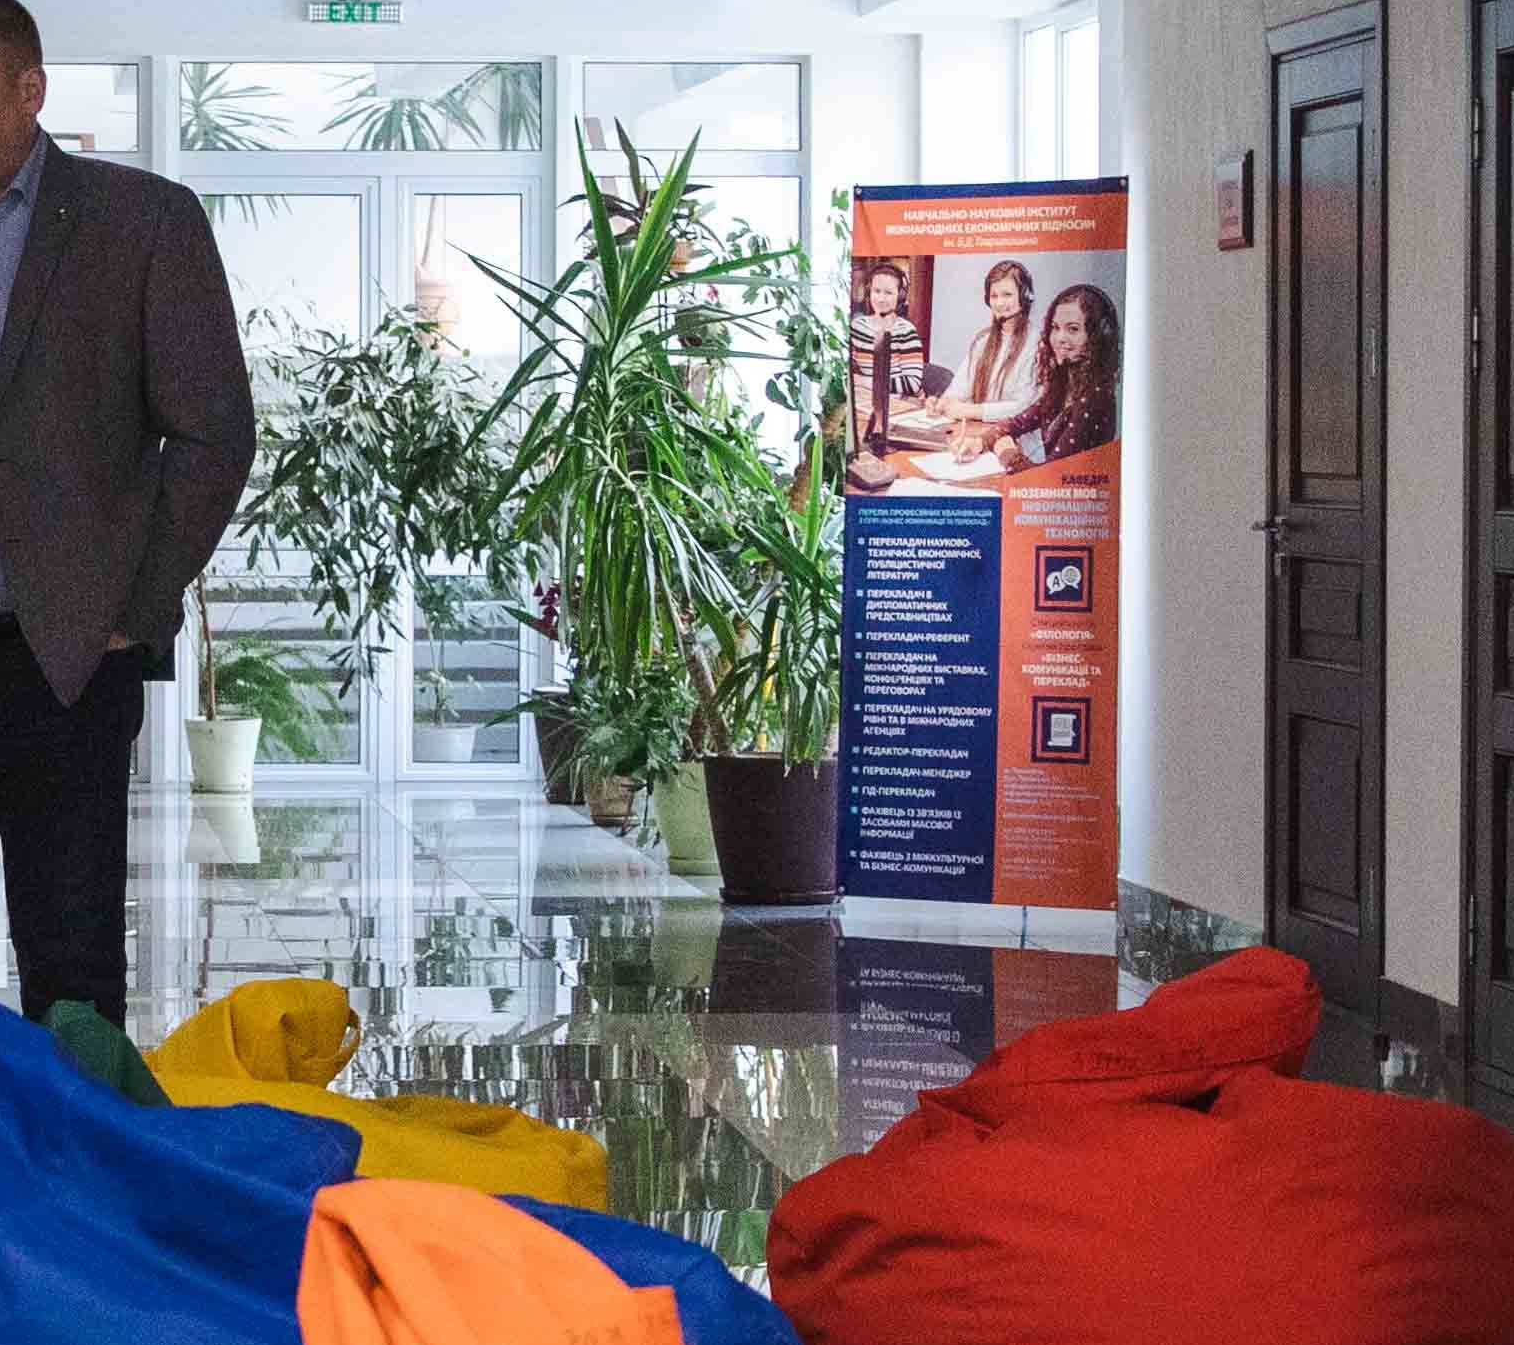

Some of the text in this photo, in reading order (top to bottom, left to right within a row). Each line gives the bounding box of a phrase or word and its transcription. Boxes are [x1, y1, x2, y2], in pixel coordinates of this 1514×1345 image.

[329, 1, 382, 22] EXIT
[868, 537, 926, 547] ПЕРЕКЛАДАЧ
[866, 589, 925, 600] ПЕРЕКЛАДАЧ
[865, 652, 938, 663] ПЕРЕКЛАДАЧ НА
[934, 676, 945, 685] ТА
[863, 685, 926, 696] ПЕРЕГОВОРАХ
[864, 704, 922, 715] ПЕРЕКЛАДАЧ
[923, 705, 936, 715] НА
[888, 716, 899, 725] ТА
[863, 746, 969, 759] РЕДАКТОР-ПЕРЕКЛАДАЧ
[863, 766, 972, 779] ПЕРЕКЛАДАЧ-МЕНЕДЖЕР
